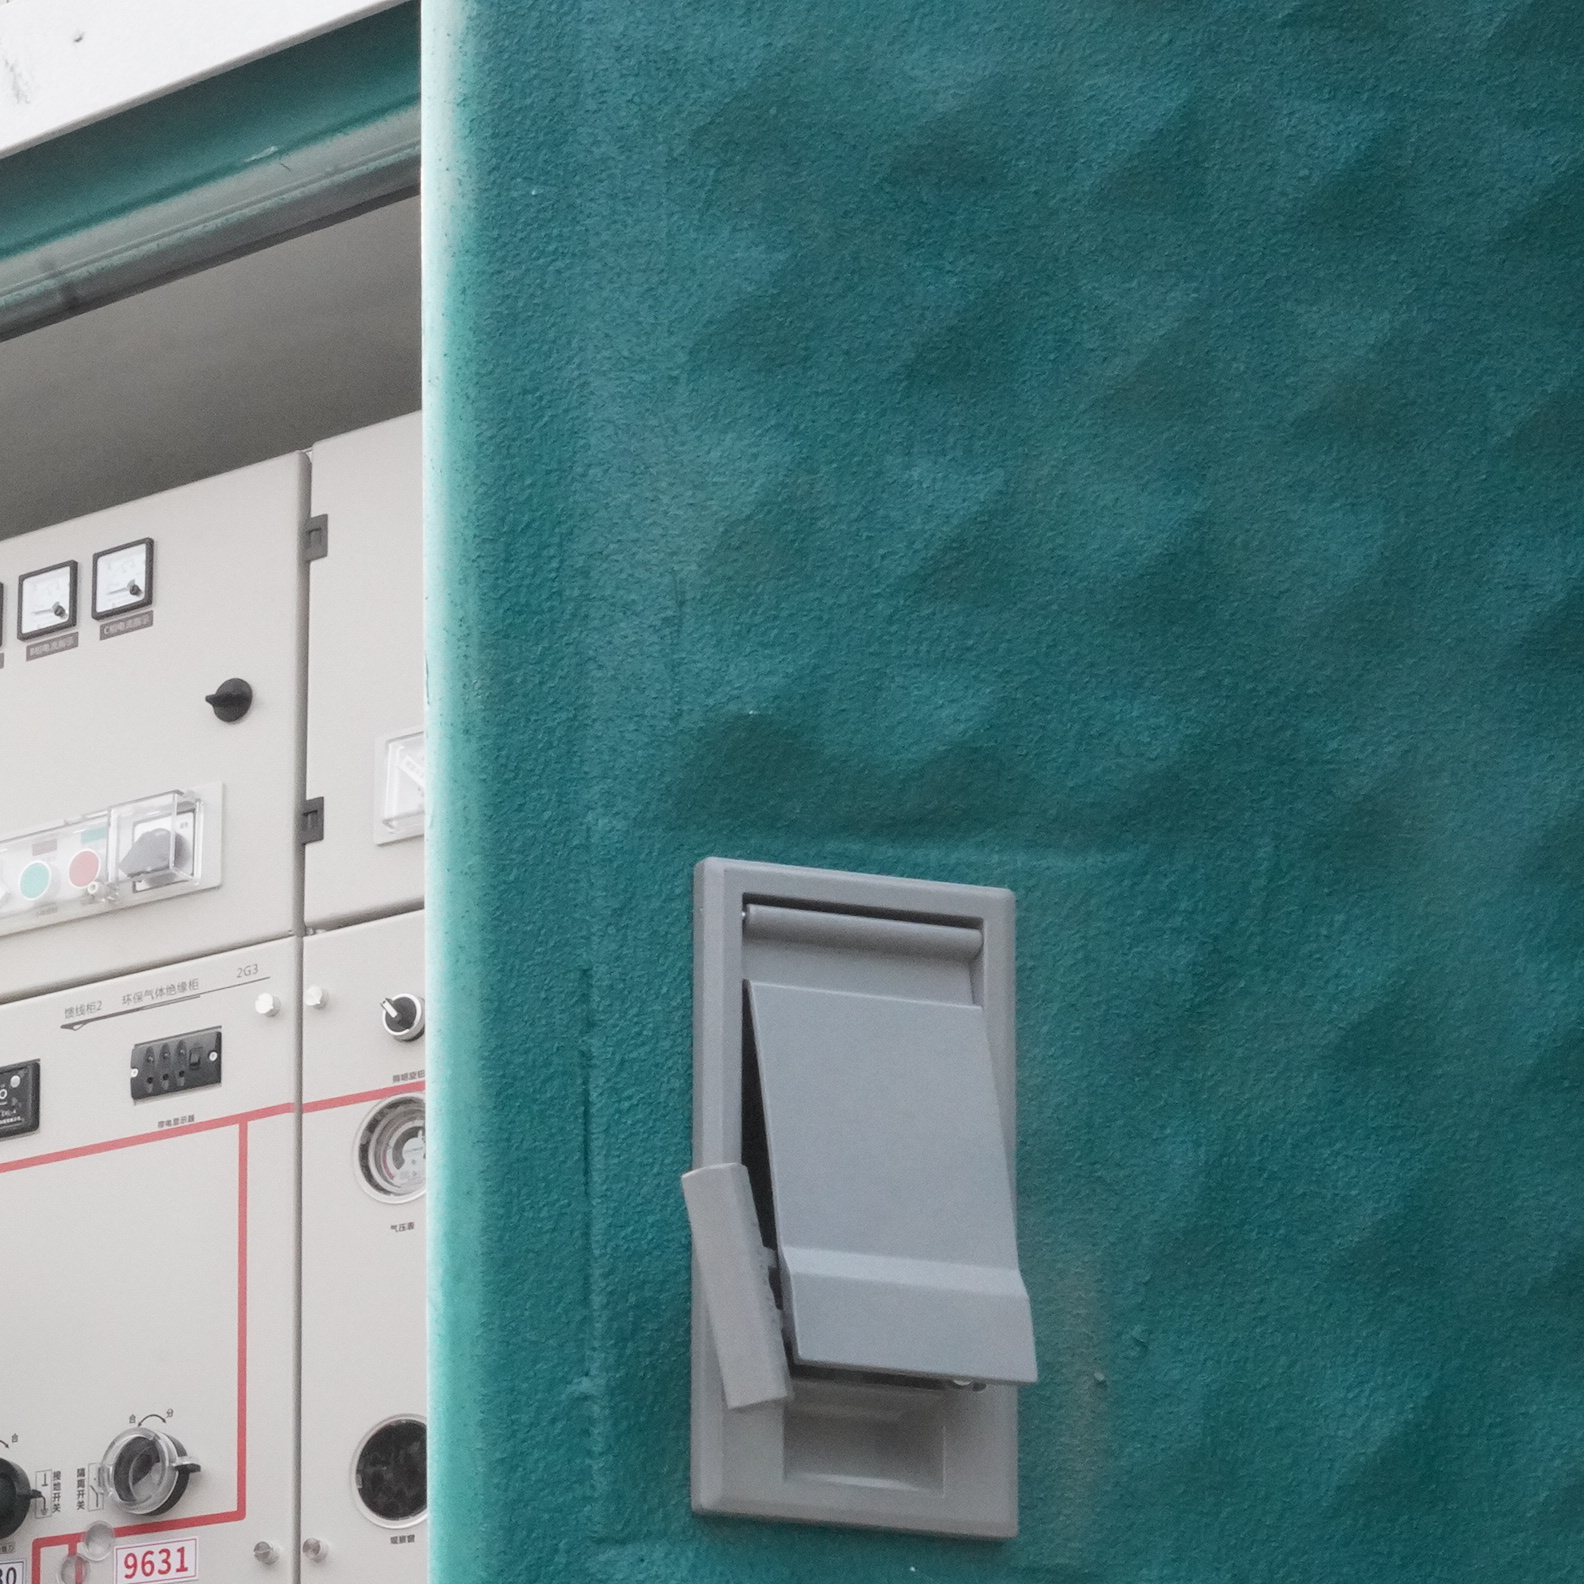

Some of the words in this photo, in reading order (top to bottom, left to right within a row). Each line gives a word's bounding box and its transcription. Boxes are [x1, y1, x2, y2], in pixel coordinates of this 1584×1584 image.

[122, 978, 199, 1006] 环保气体绝缘柜
[237, 964, 259, 979] 2G3
[123, 1546, 189, 1579] 9631
